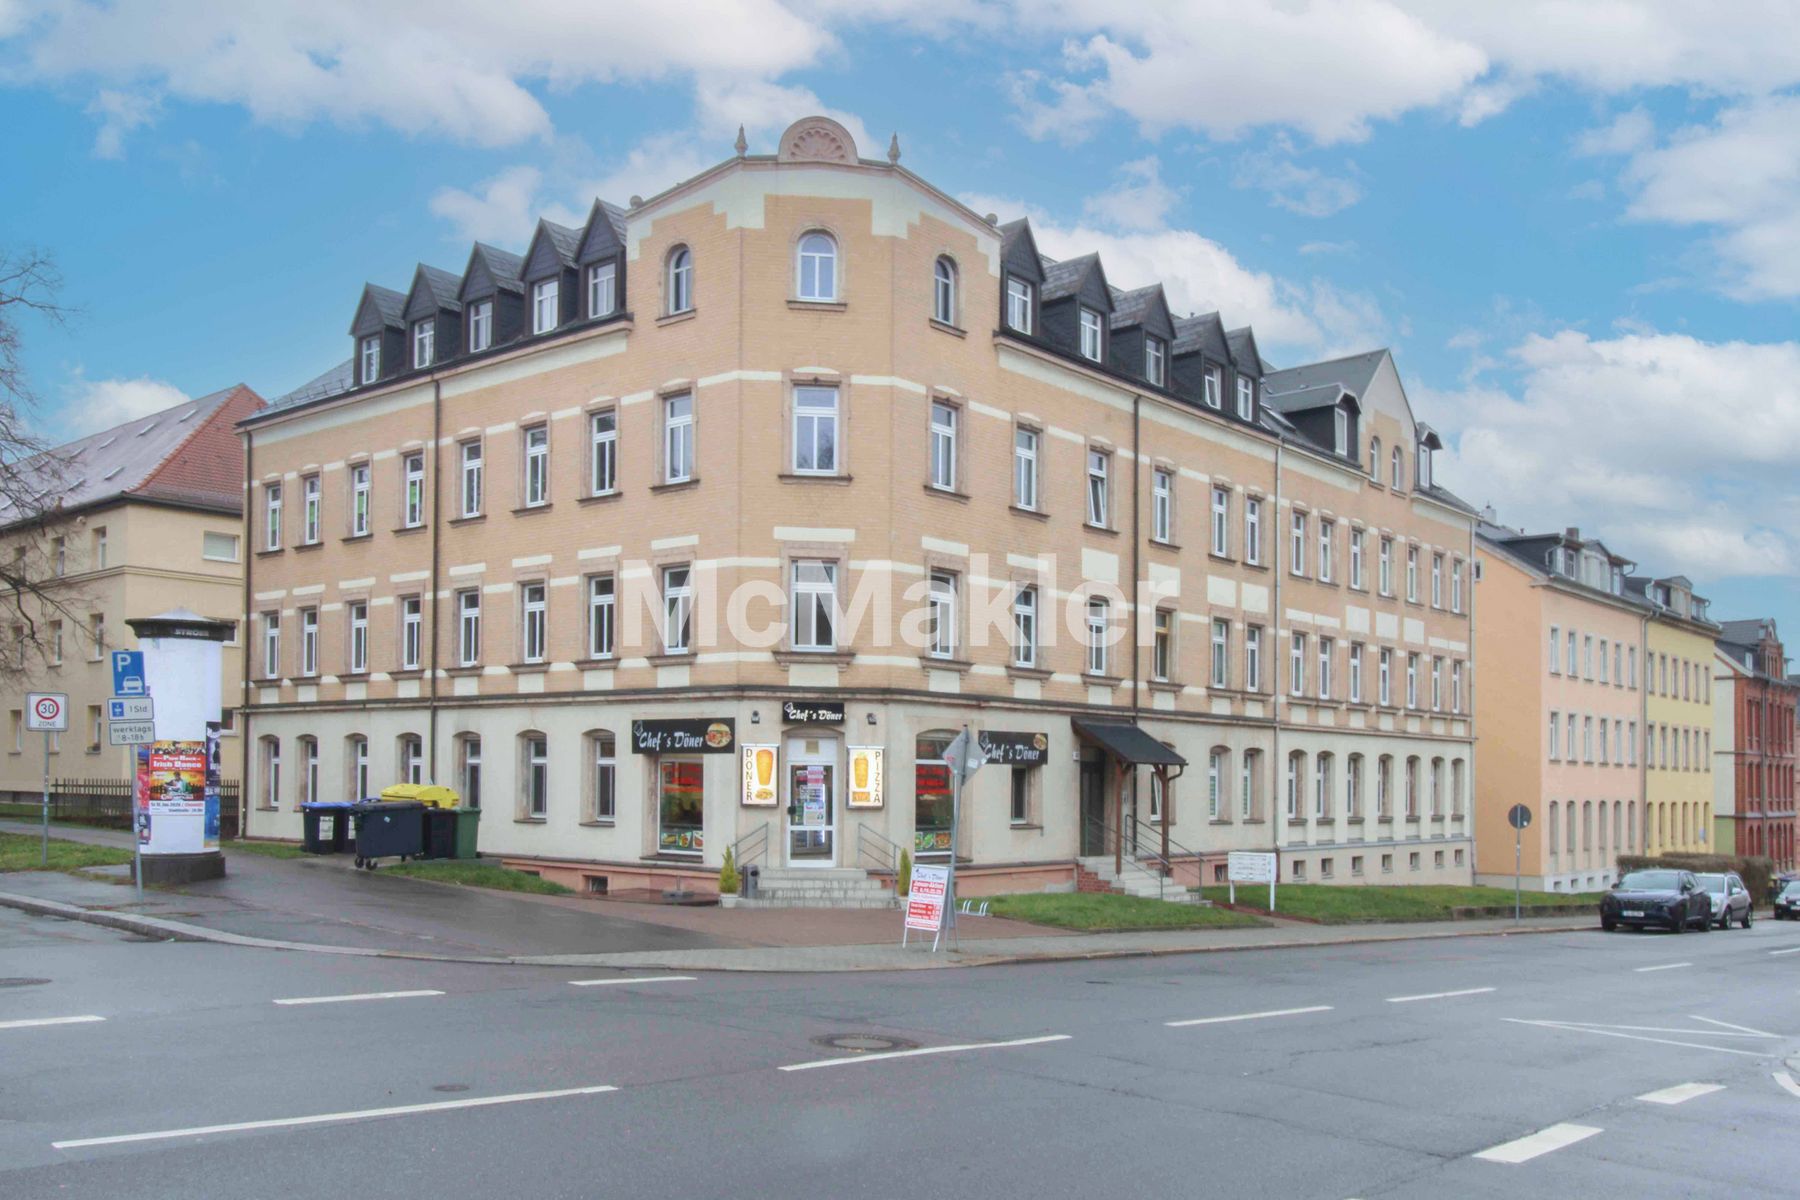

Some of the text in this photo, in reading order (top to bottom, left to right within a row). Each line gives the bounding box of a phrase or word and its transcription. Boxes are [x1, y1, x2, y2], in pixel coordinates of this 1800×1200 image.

[117, 654, 131, 672] P
[40, 703, 55, 714] 30
[818, 709, 842, 720] Döner
[113, 725, 152, 734] werktags
[673, 731, 703, 748] Döner
[1014, 744, 1040, 760] Döner
